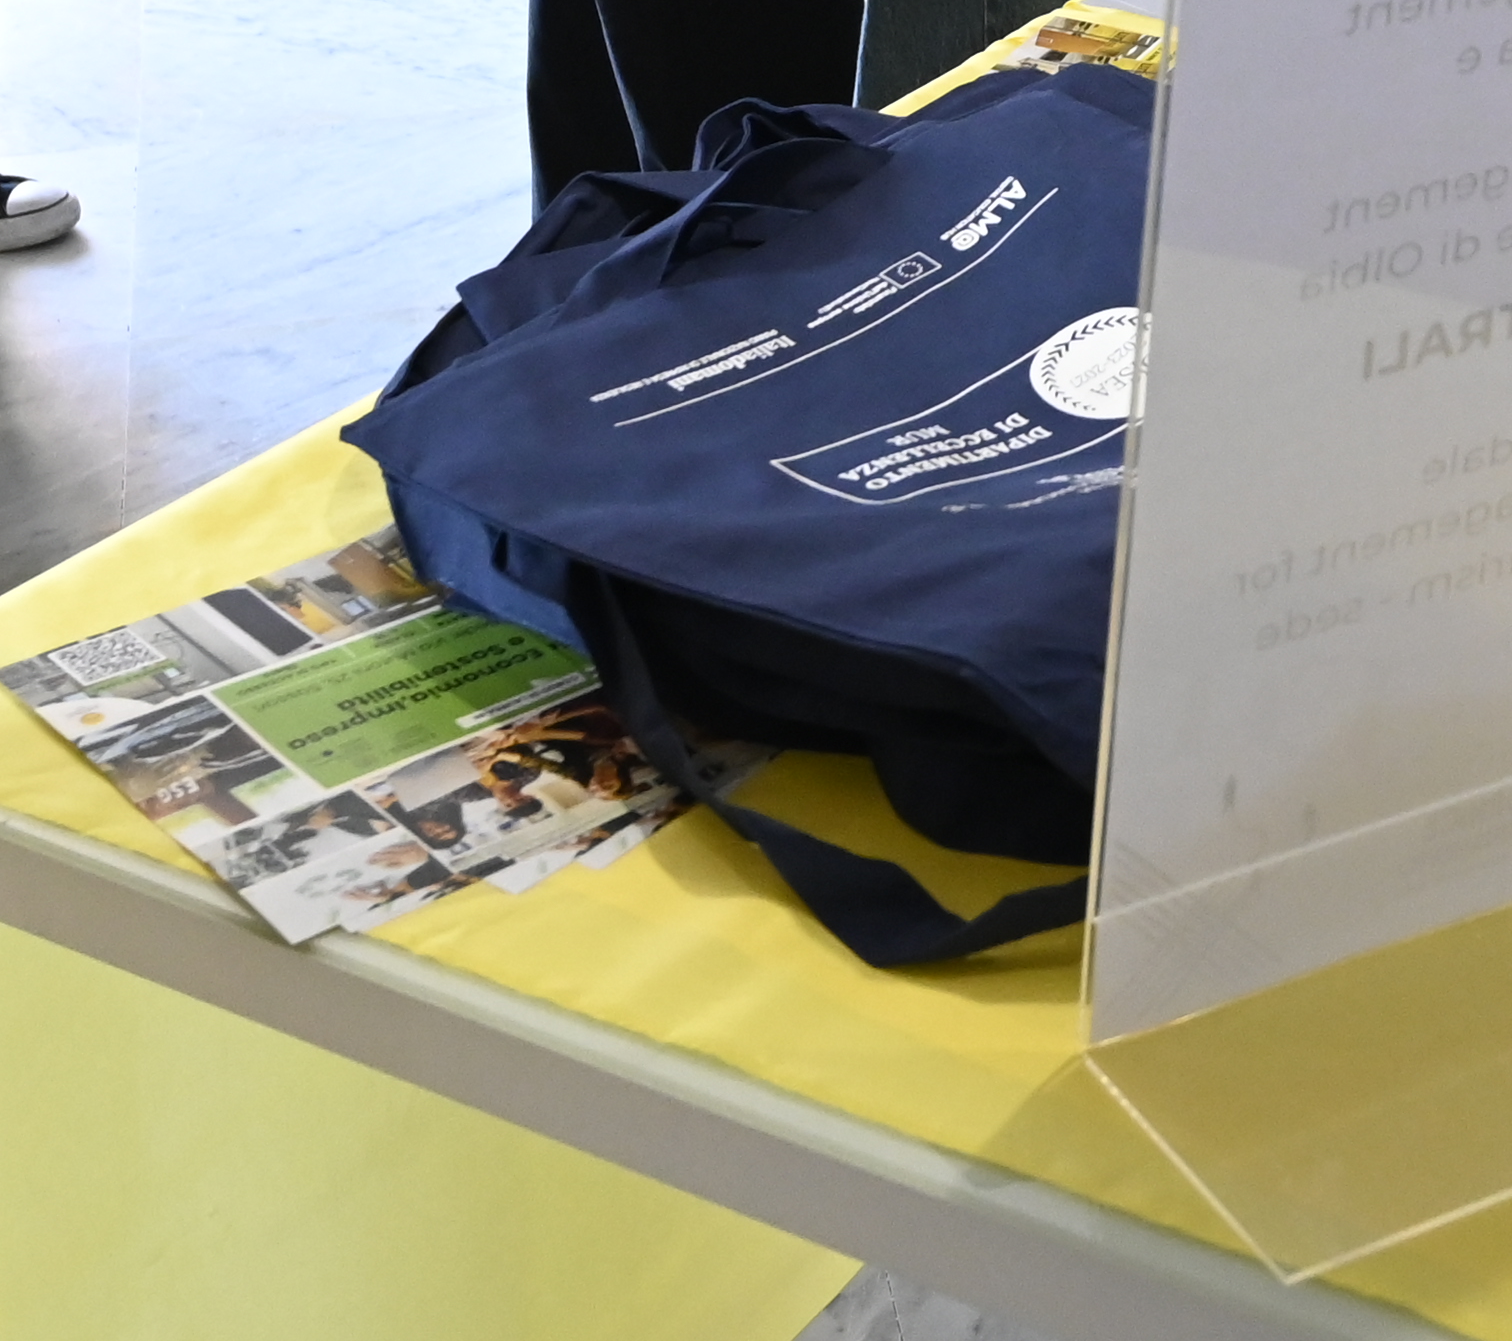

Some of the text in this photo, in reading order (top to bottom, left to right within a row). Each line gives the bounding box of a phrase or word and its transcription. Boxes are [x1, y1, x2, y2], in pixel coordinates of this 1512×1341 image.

[951, 179, 1027, 251] ALM@
[667, 334, 797, 392] Italiadomani
[1091, 360, 1150, 400] SEA
[838, 412, 1030, 482] DI ECCELLENZA
[865, 425, 1053, 491] DIPARTIMENTO
[886, 424, 951, 447] MUR
[288, 697, 407, 750] Impresa
[157, 776, 200, 803] ESG
